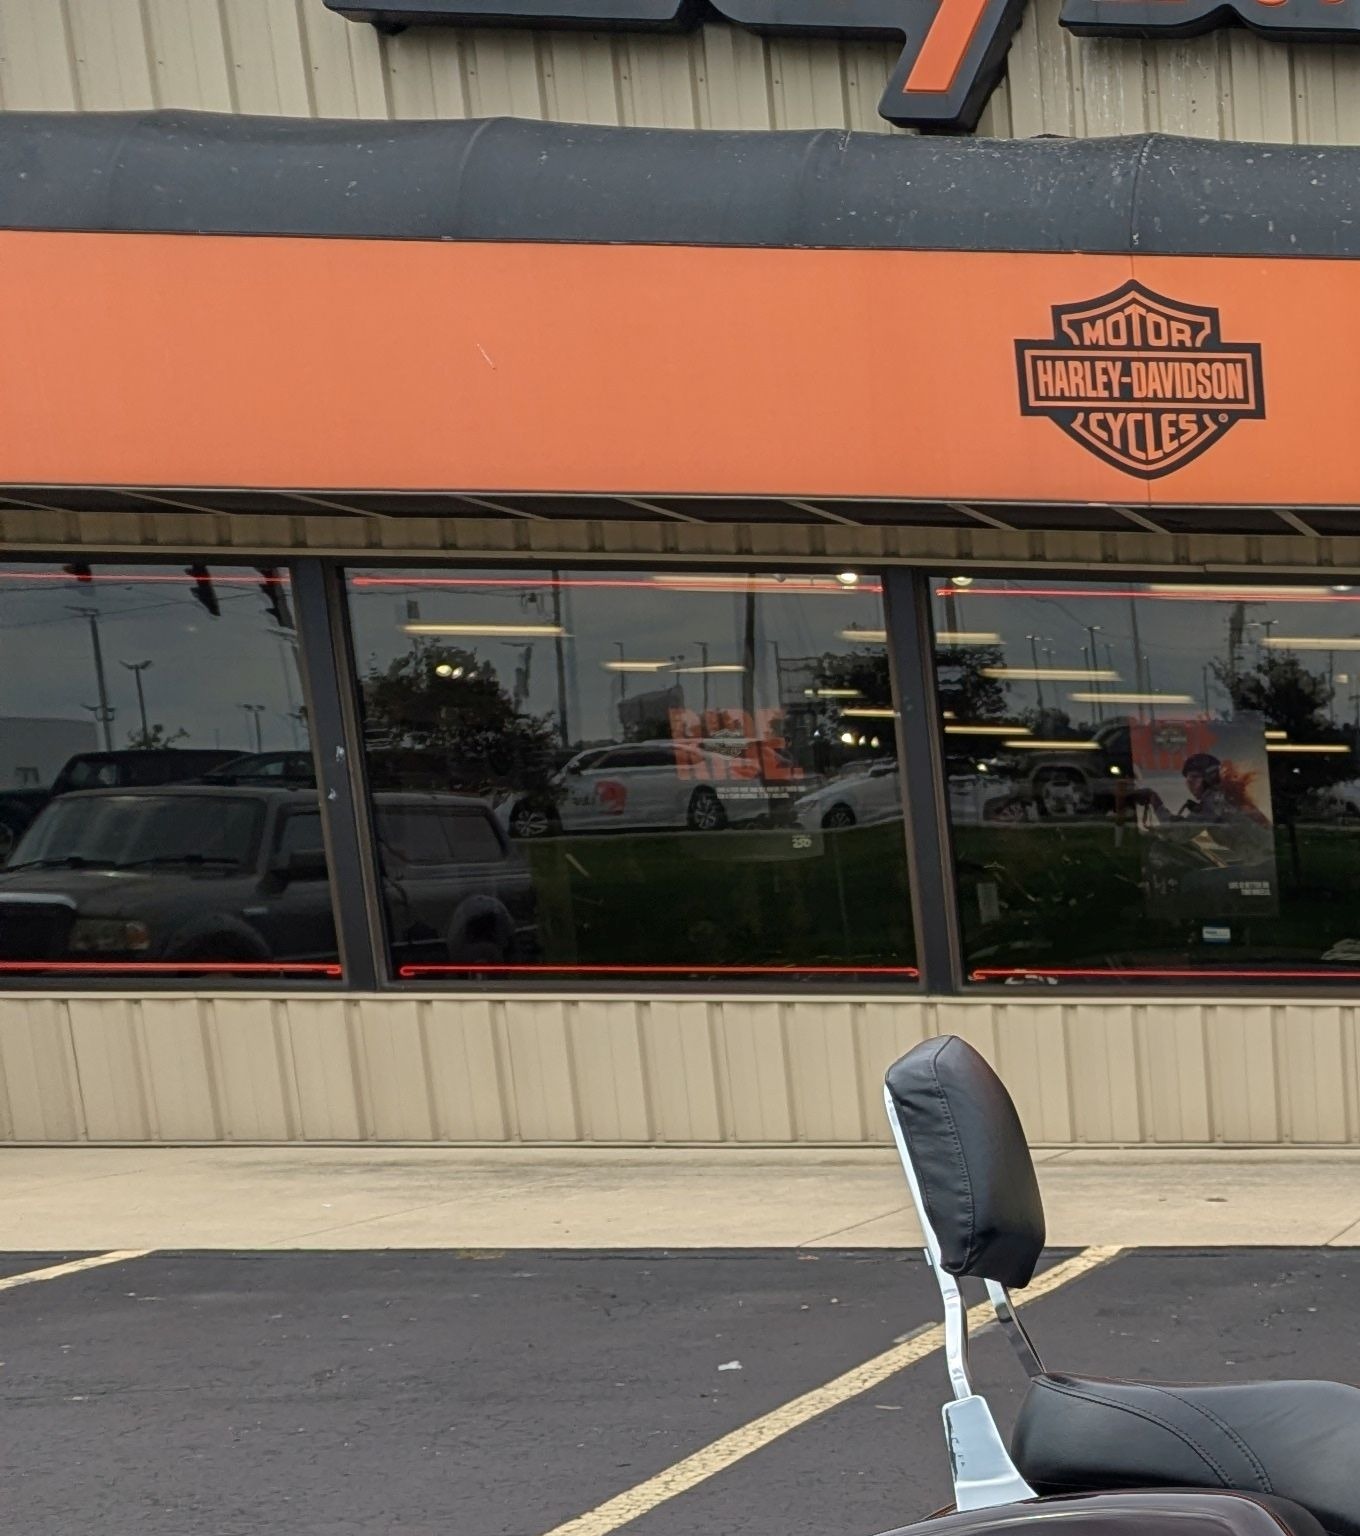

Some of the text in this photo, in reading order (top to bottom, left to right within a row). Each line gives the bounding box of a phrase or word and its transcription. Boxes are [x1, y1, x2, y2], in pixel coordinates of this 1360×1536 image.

[1082, 303, 1193, 347] MOTOR
[1036, 360, 1245, 400] HARLEY-DAVIDSON
[1089, 412, 1199, 461] CYCLES
